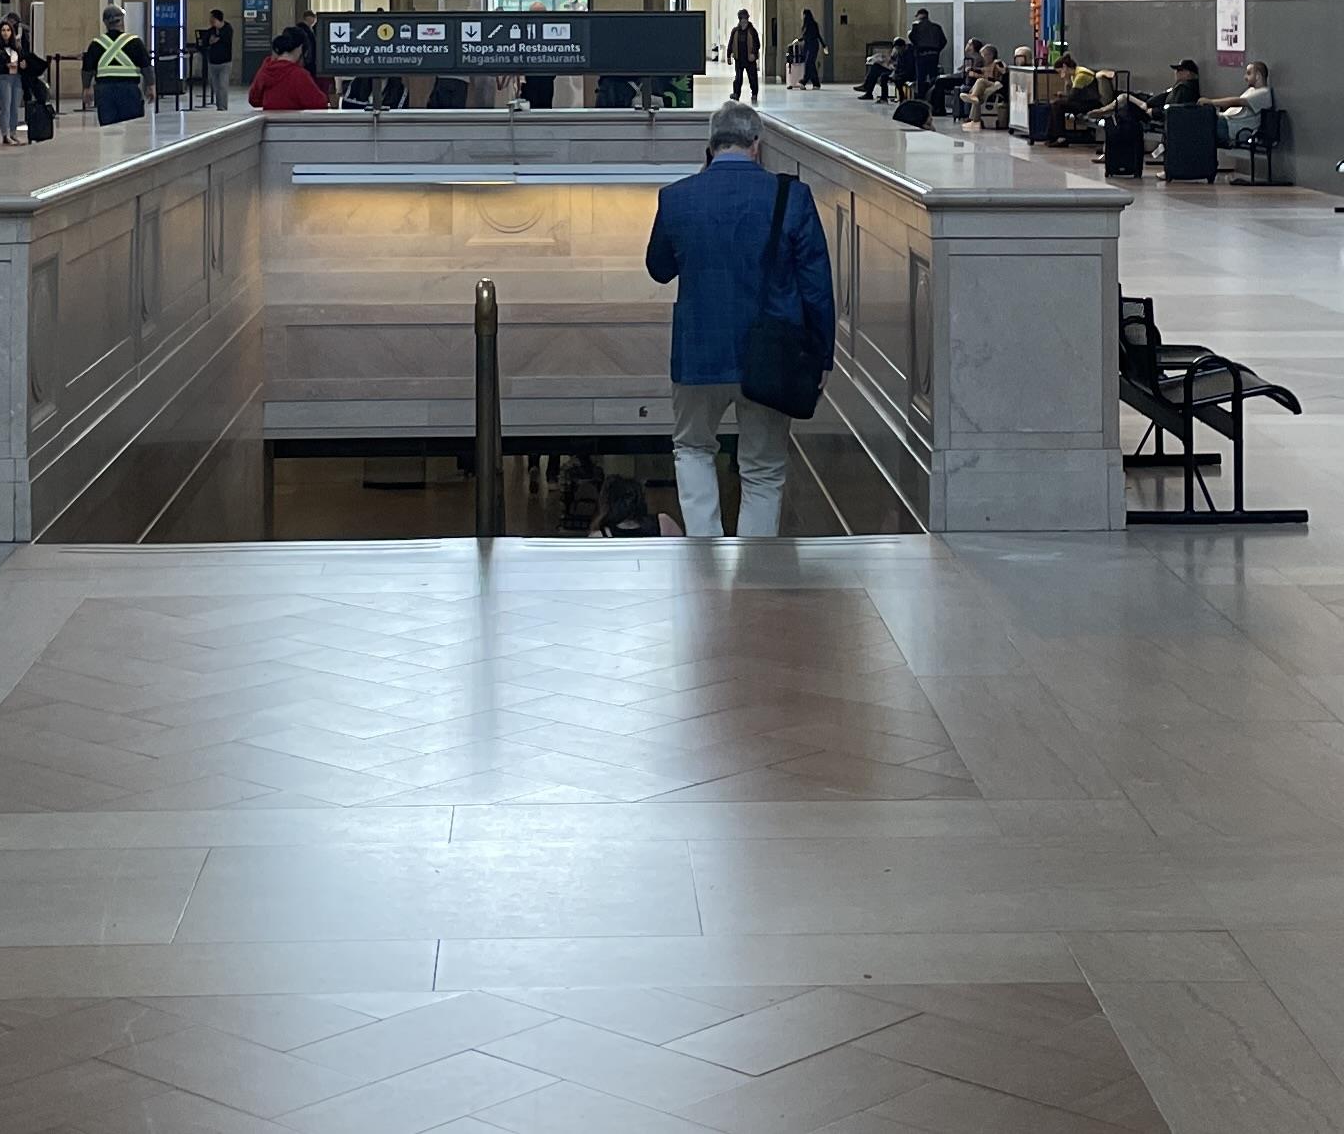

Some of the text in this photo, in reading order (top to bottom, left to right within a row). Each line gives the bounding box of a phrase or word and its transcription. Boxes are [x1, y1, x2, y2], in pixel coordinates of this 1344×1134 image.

[329, 44, 449, 54] Subway and streetcars
[462, 43, 581, 54] Shops and Restaurants
[330, 54, 424, 66] Métro et tramway
[462, 54, 586, 66] Magasins et restaurants
